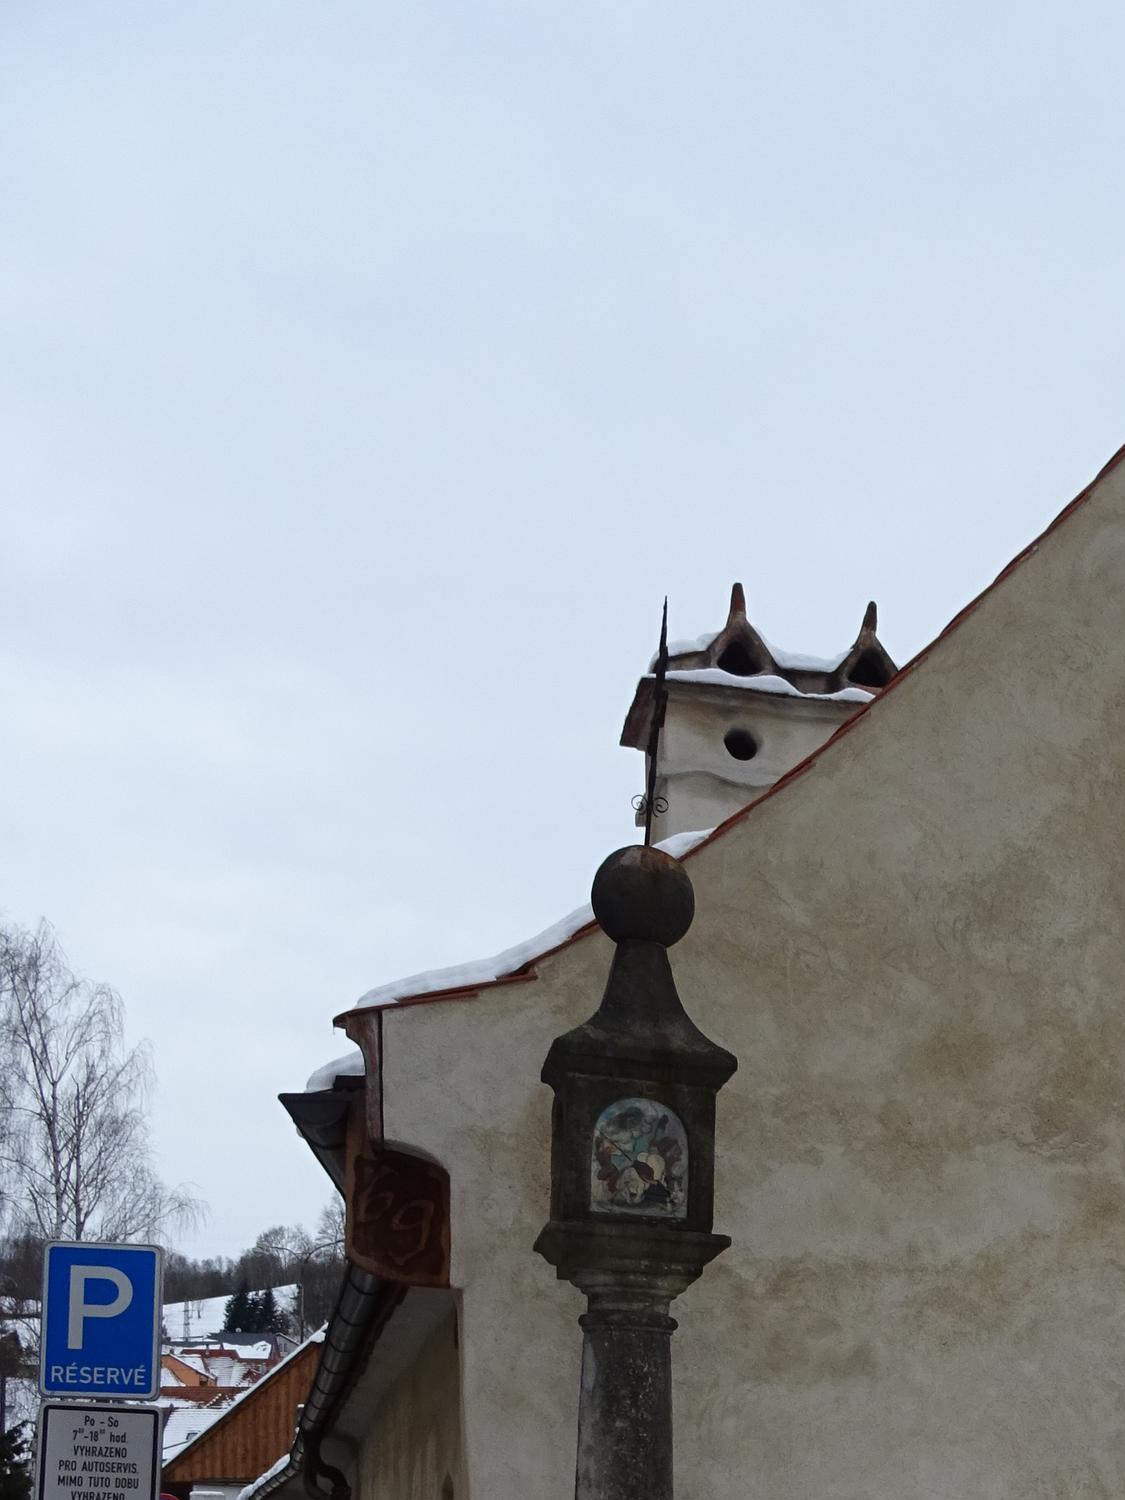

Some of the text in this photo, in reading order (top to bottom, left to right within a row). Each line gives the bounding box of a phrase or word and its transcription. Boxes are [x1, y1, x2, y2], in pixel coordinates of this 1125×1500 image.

[67, 1264, 134, 1350] P
[51, 1363, 146, 1386] RÉSERVÉ
[74, 1446, 127, 1458] VYHRAZENO
[58, 1460, 77, 1471] PRO
[57, 1475, 139, 1489] MIMO TUTO DOBU
